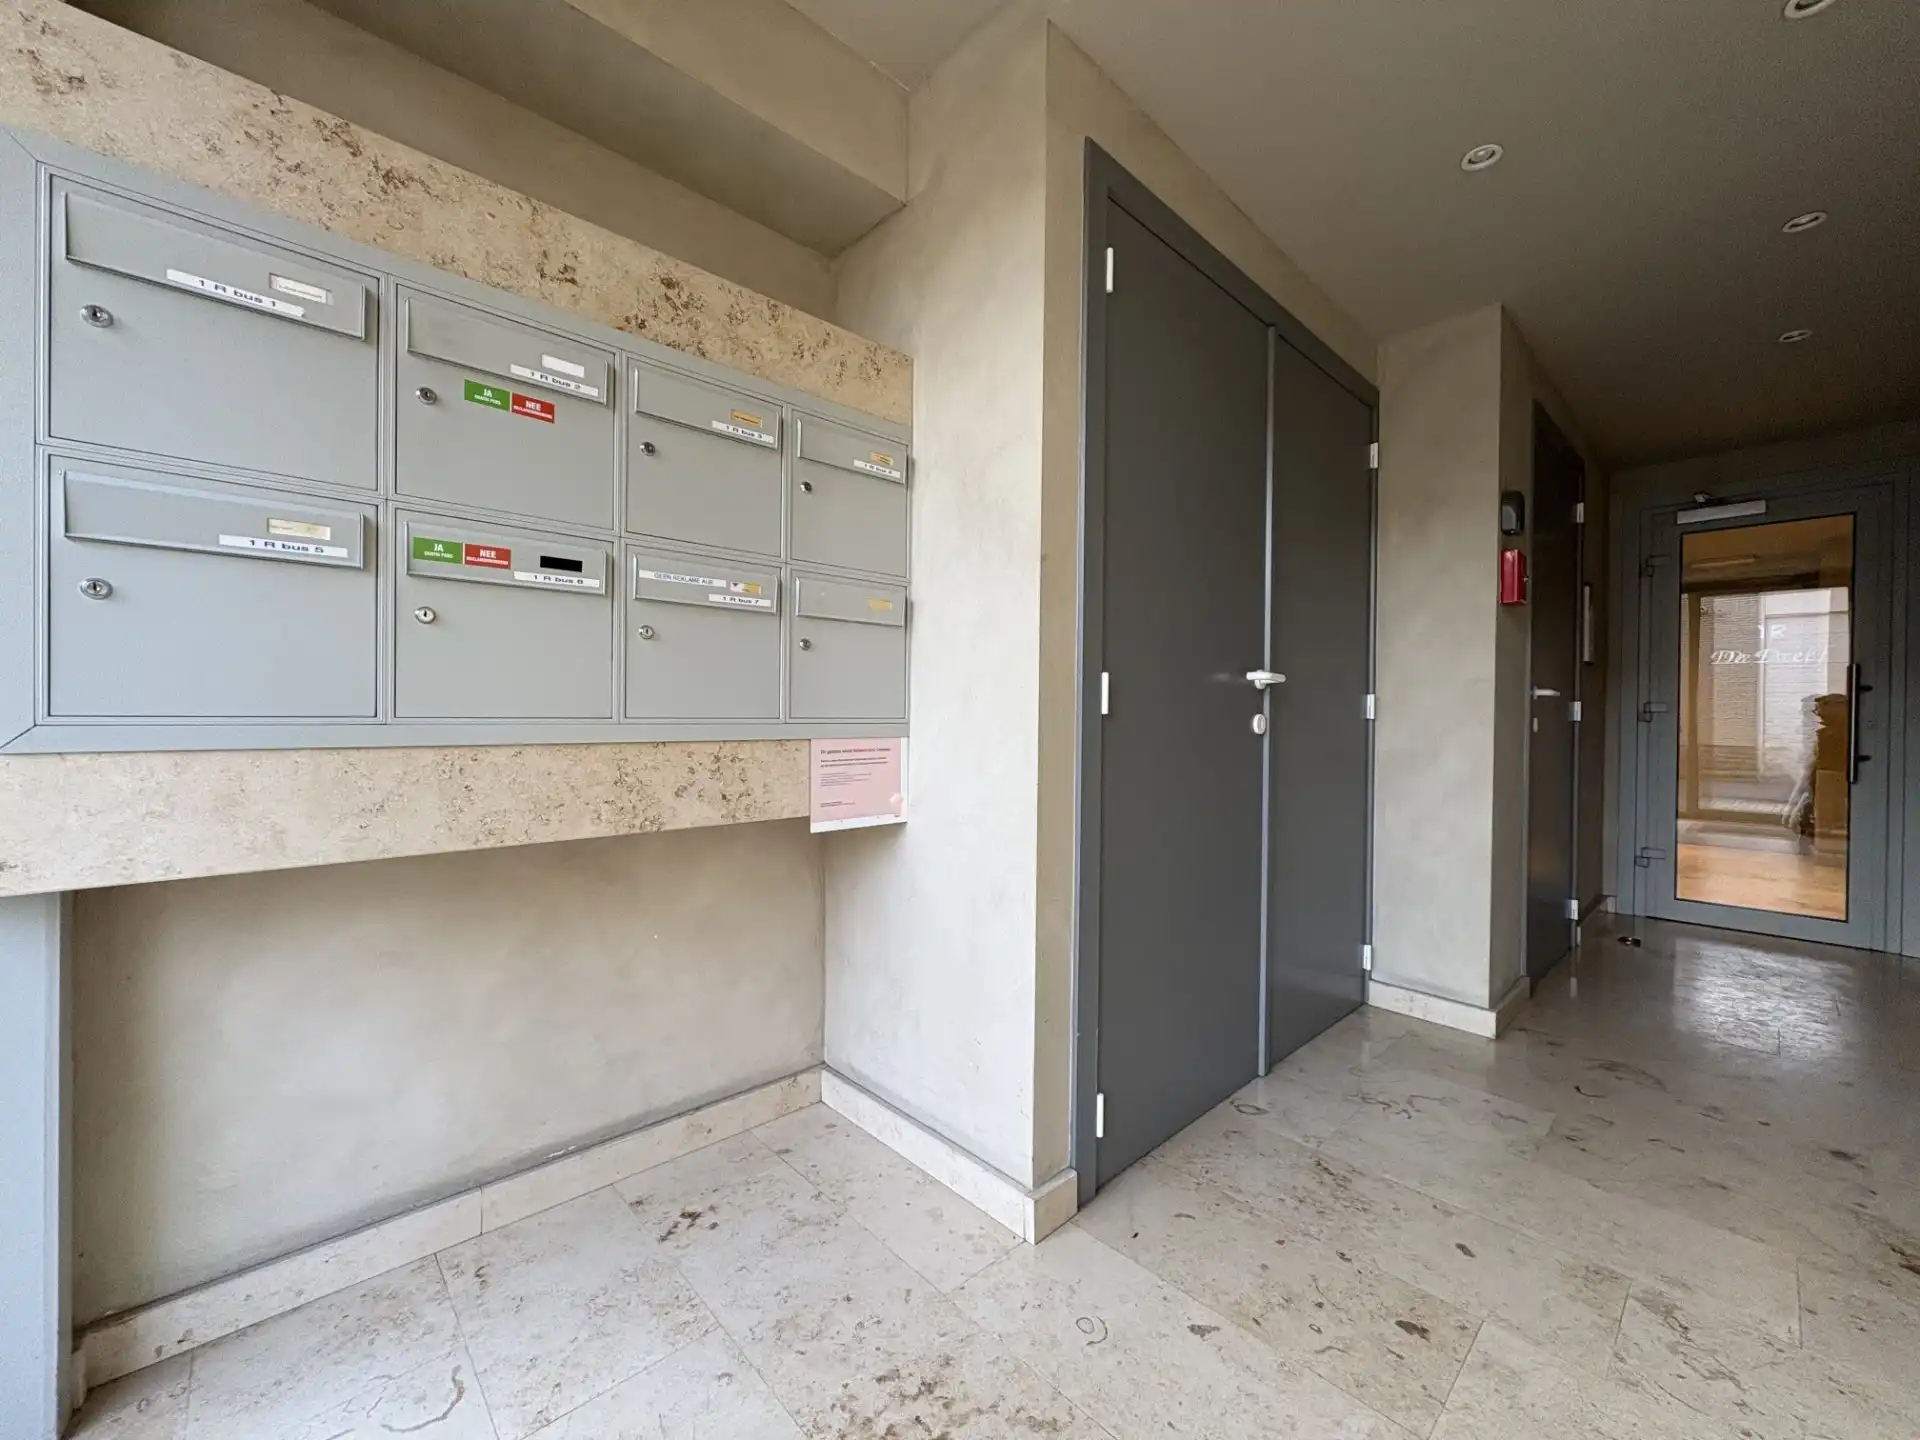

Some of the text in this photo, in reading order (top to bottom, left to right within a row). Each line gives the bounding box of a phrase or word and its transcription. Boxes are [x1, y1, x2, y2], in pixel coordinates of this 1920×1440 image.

[214, 284, 226, 293] R
[234, 286, 263, 303] bus
[552, 378, 571, 388] bus
[484, 388, 493, 398] JA
[525, 400, 542, 411] NEE
[281, 543, 309, 552] bus
[434, 543, 444, 552] JA
[480, 549, 496, 559] NEE
